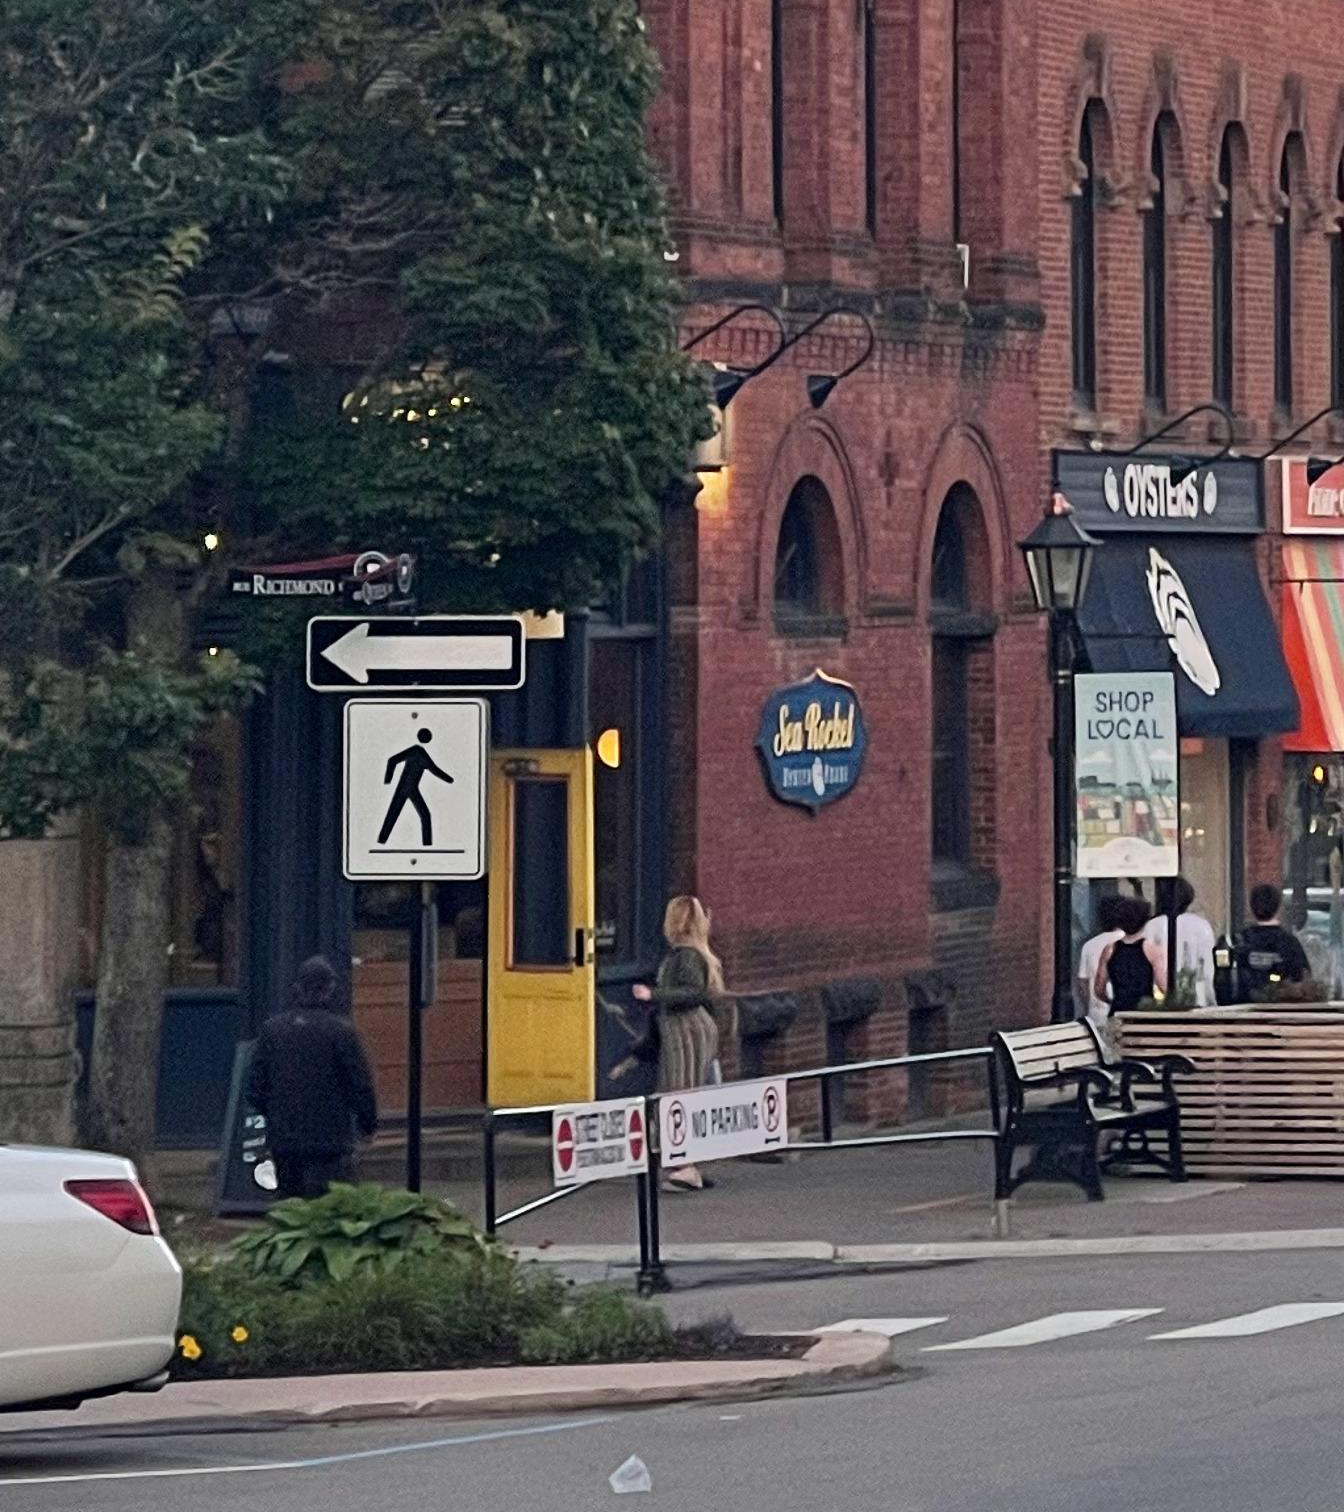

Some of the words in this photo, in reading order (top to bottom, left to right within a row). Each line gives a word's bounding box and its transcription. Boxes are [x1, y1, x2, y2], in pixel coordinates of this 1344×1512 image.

[252, 574, 335, 596] RICHMOND
[1095, 691, 1155, 713] SHOP
[1087, 718, 1165, 740] LOCAL
[692, 1109, 707, 1138] NO
[711, 1102, 759, 1135] PARKING
